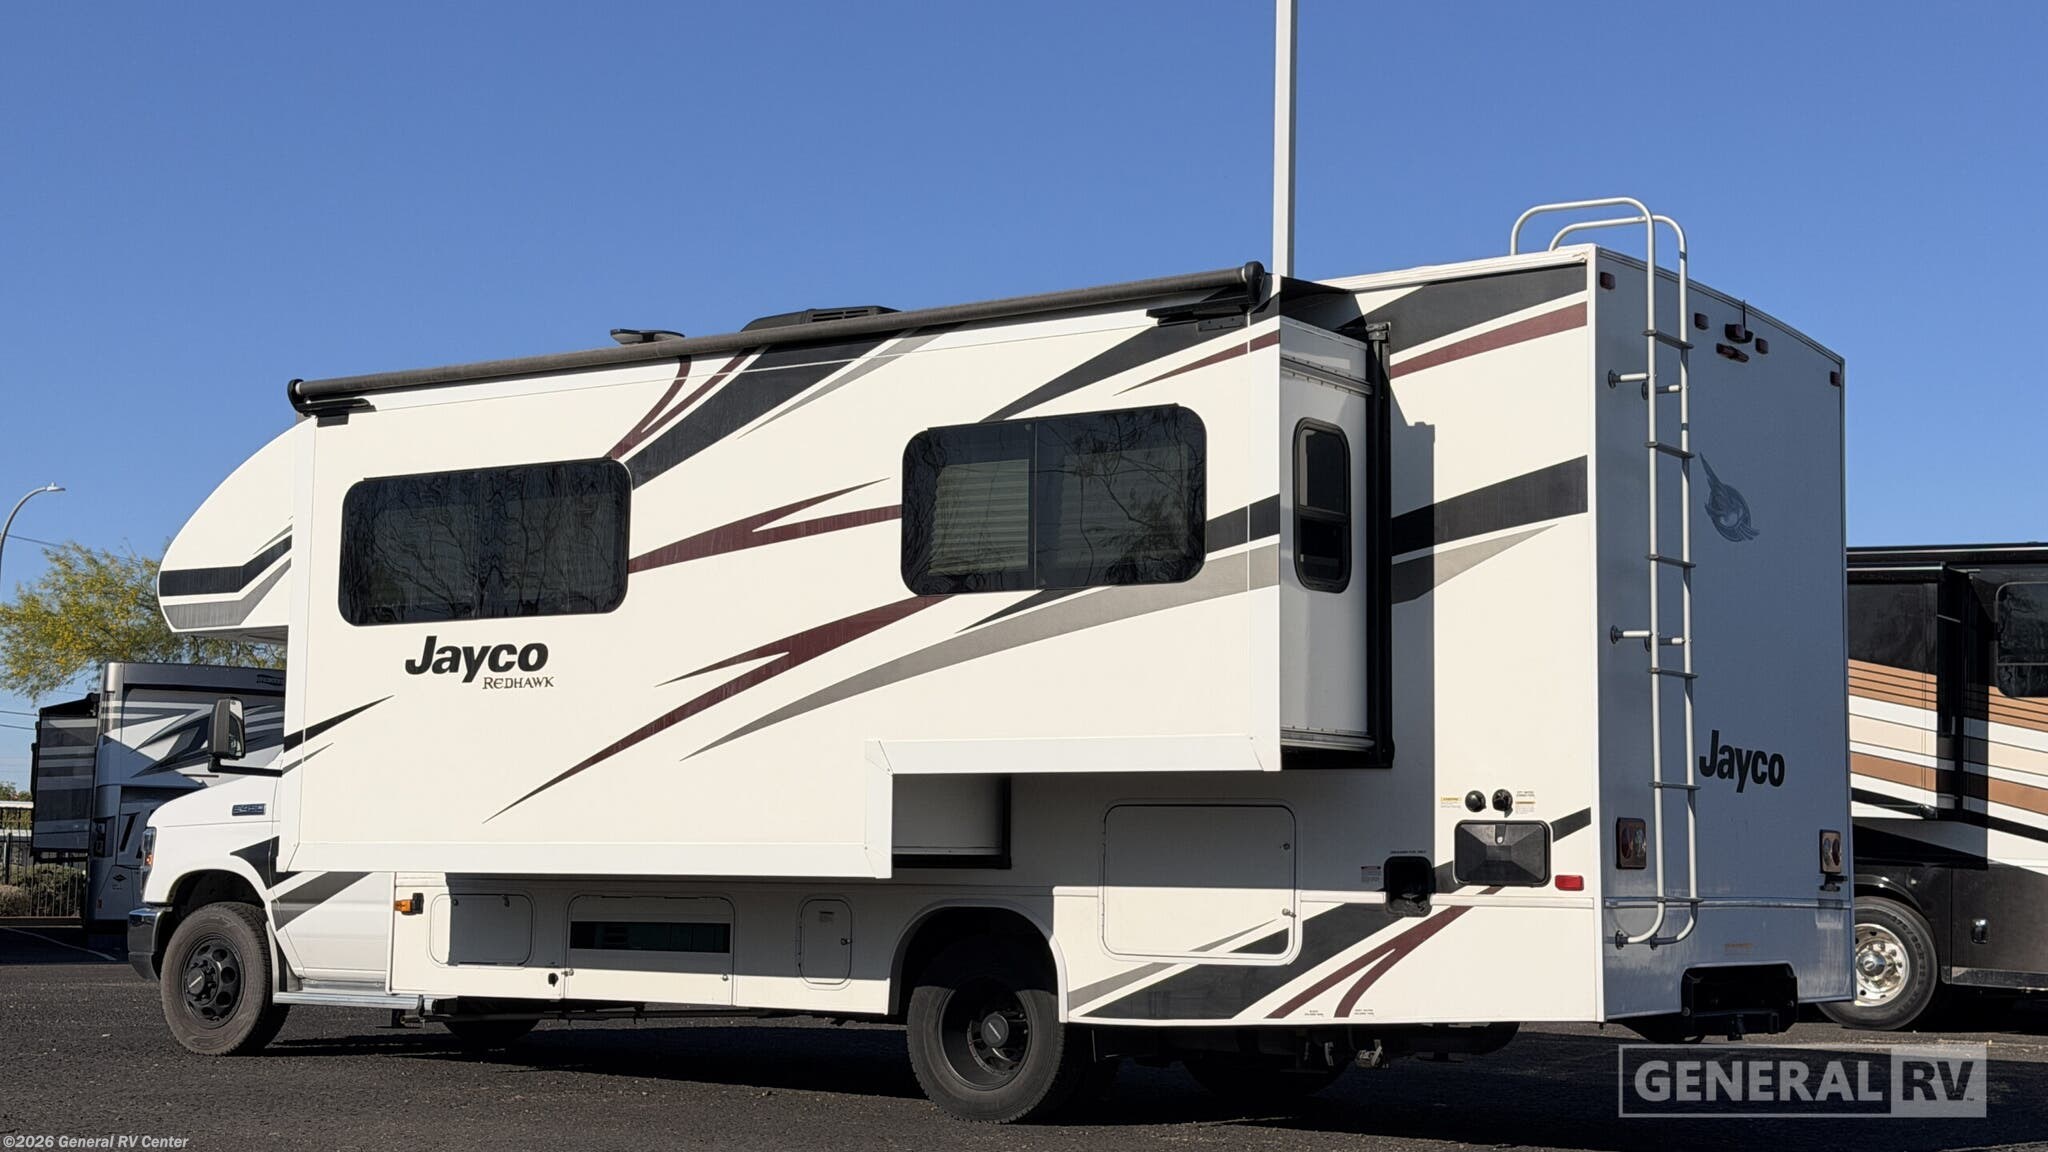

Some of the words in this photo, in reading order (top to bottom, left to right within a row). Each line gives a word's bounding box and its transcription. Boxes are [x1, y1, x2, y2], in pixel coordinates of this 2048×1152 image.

[405, 635, 549, 683] Jayco
[482, 676, 554, 689] REDHAWK
[1699, 729, 1785, 793] Jayco
